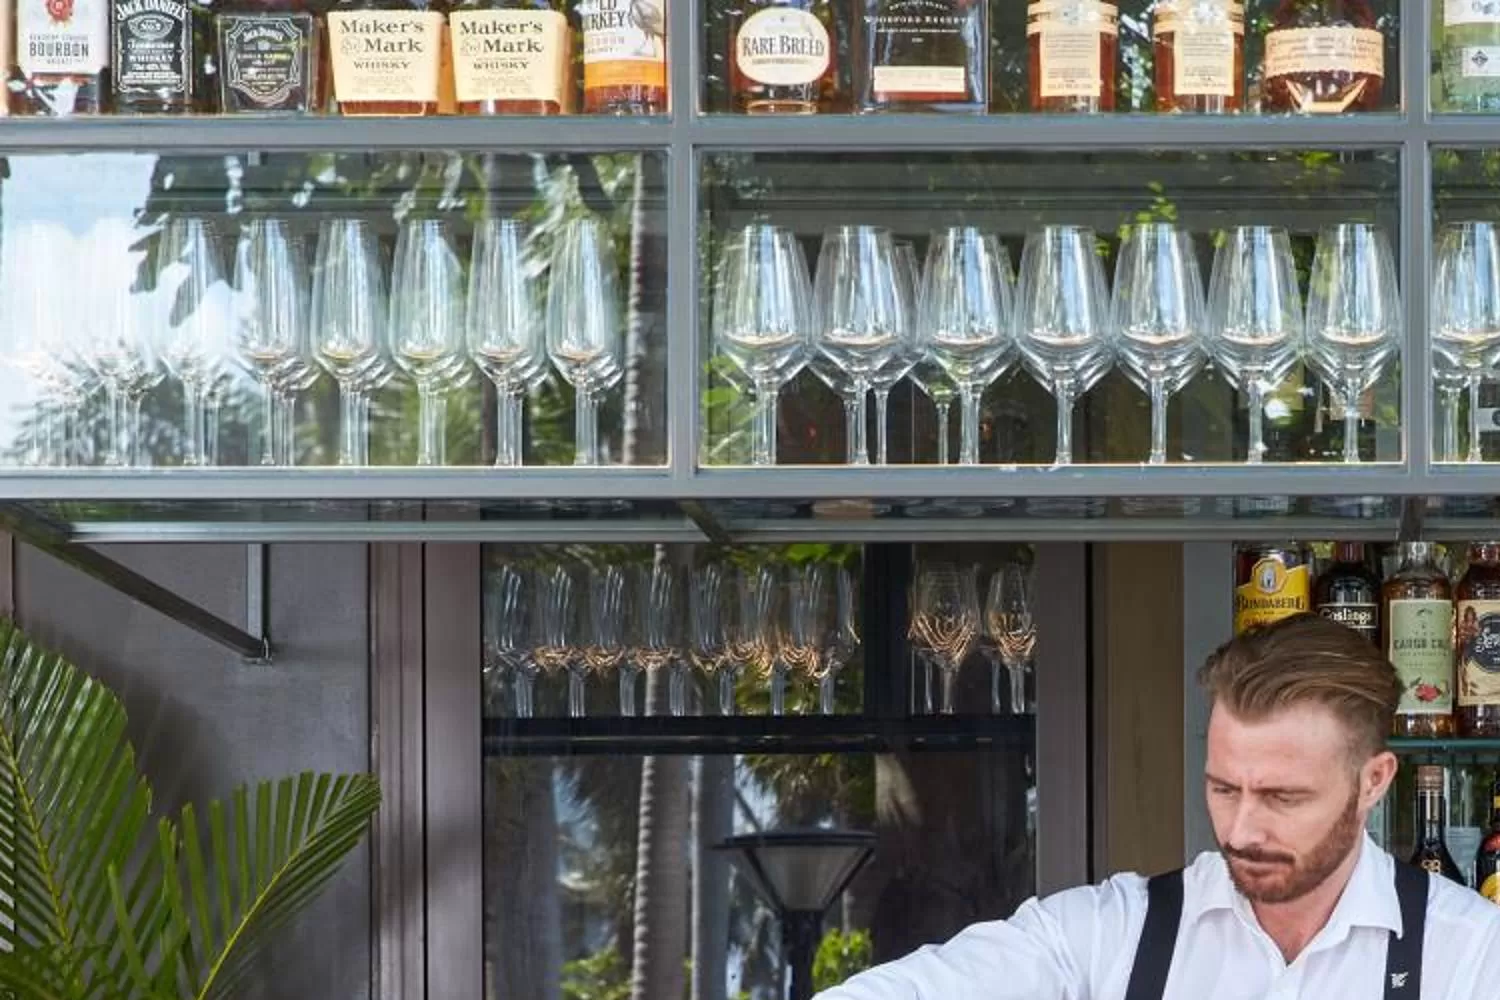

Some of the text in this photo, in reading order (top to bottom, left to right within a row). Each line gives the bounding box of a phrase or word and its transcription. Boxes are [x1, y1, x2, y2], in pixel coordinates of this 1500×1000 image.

[338, 19, 425, 35] Maker's
[459, 19, 544, 35] Maker's
[29, 41, 89, 57] BOURBON
[363, 36, 424, 54] Mark
[482, 36, 545, 54] Mark
[742, 35, 825, 57] RARE BREED
[353, 60, 412, 70] WHISKY
[472, 60, 530, 70] WHISKY
[1321, 607, 1373, 625] Goslings
